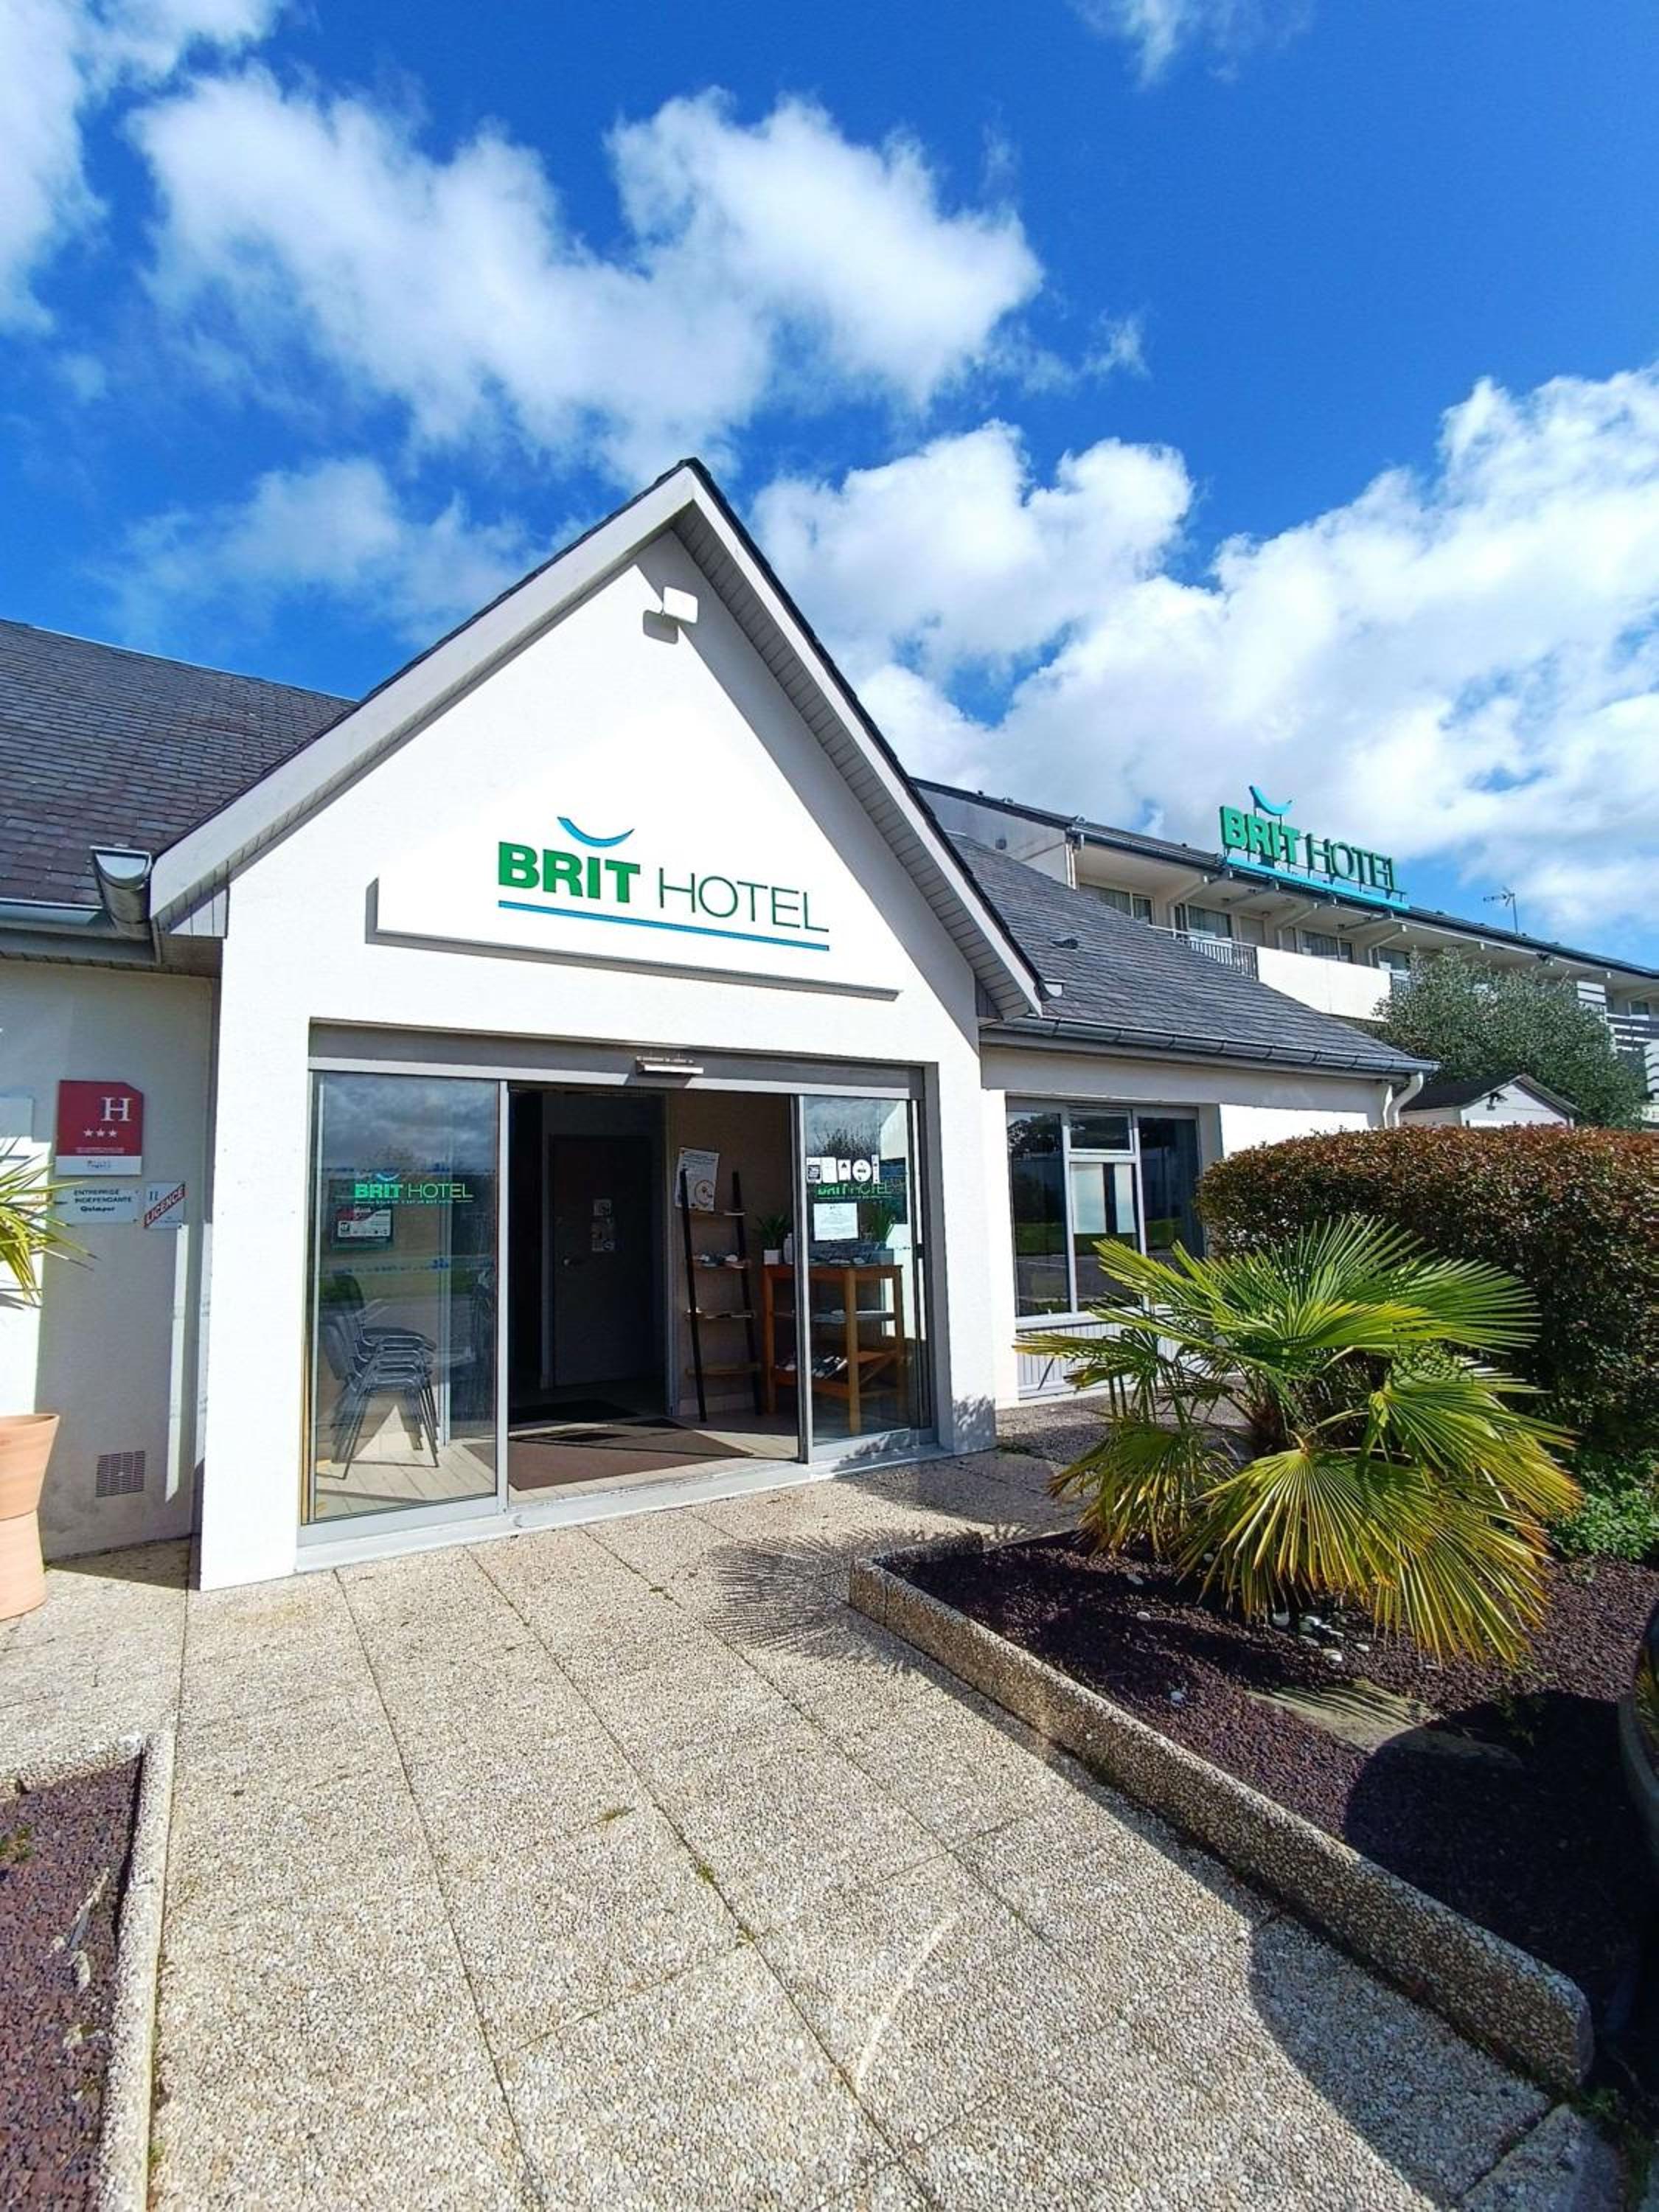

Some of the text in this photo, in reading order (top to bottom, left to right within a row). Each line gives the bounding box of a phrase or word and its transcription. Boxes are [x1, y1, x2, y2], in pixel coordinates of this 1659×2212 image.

[1220, 806, 1406, 895] BRIT HOTEL
[498, 841, 829, 932] BRIT HOTEL
[100, 1096, 133, 1122] H
[146, 1187, 184, 1224] LICENCE
[355, 1183, 474, 1198] BRIT HOTEL
